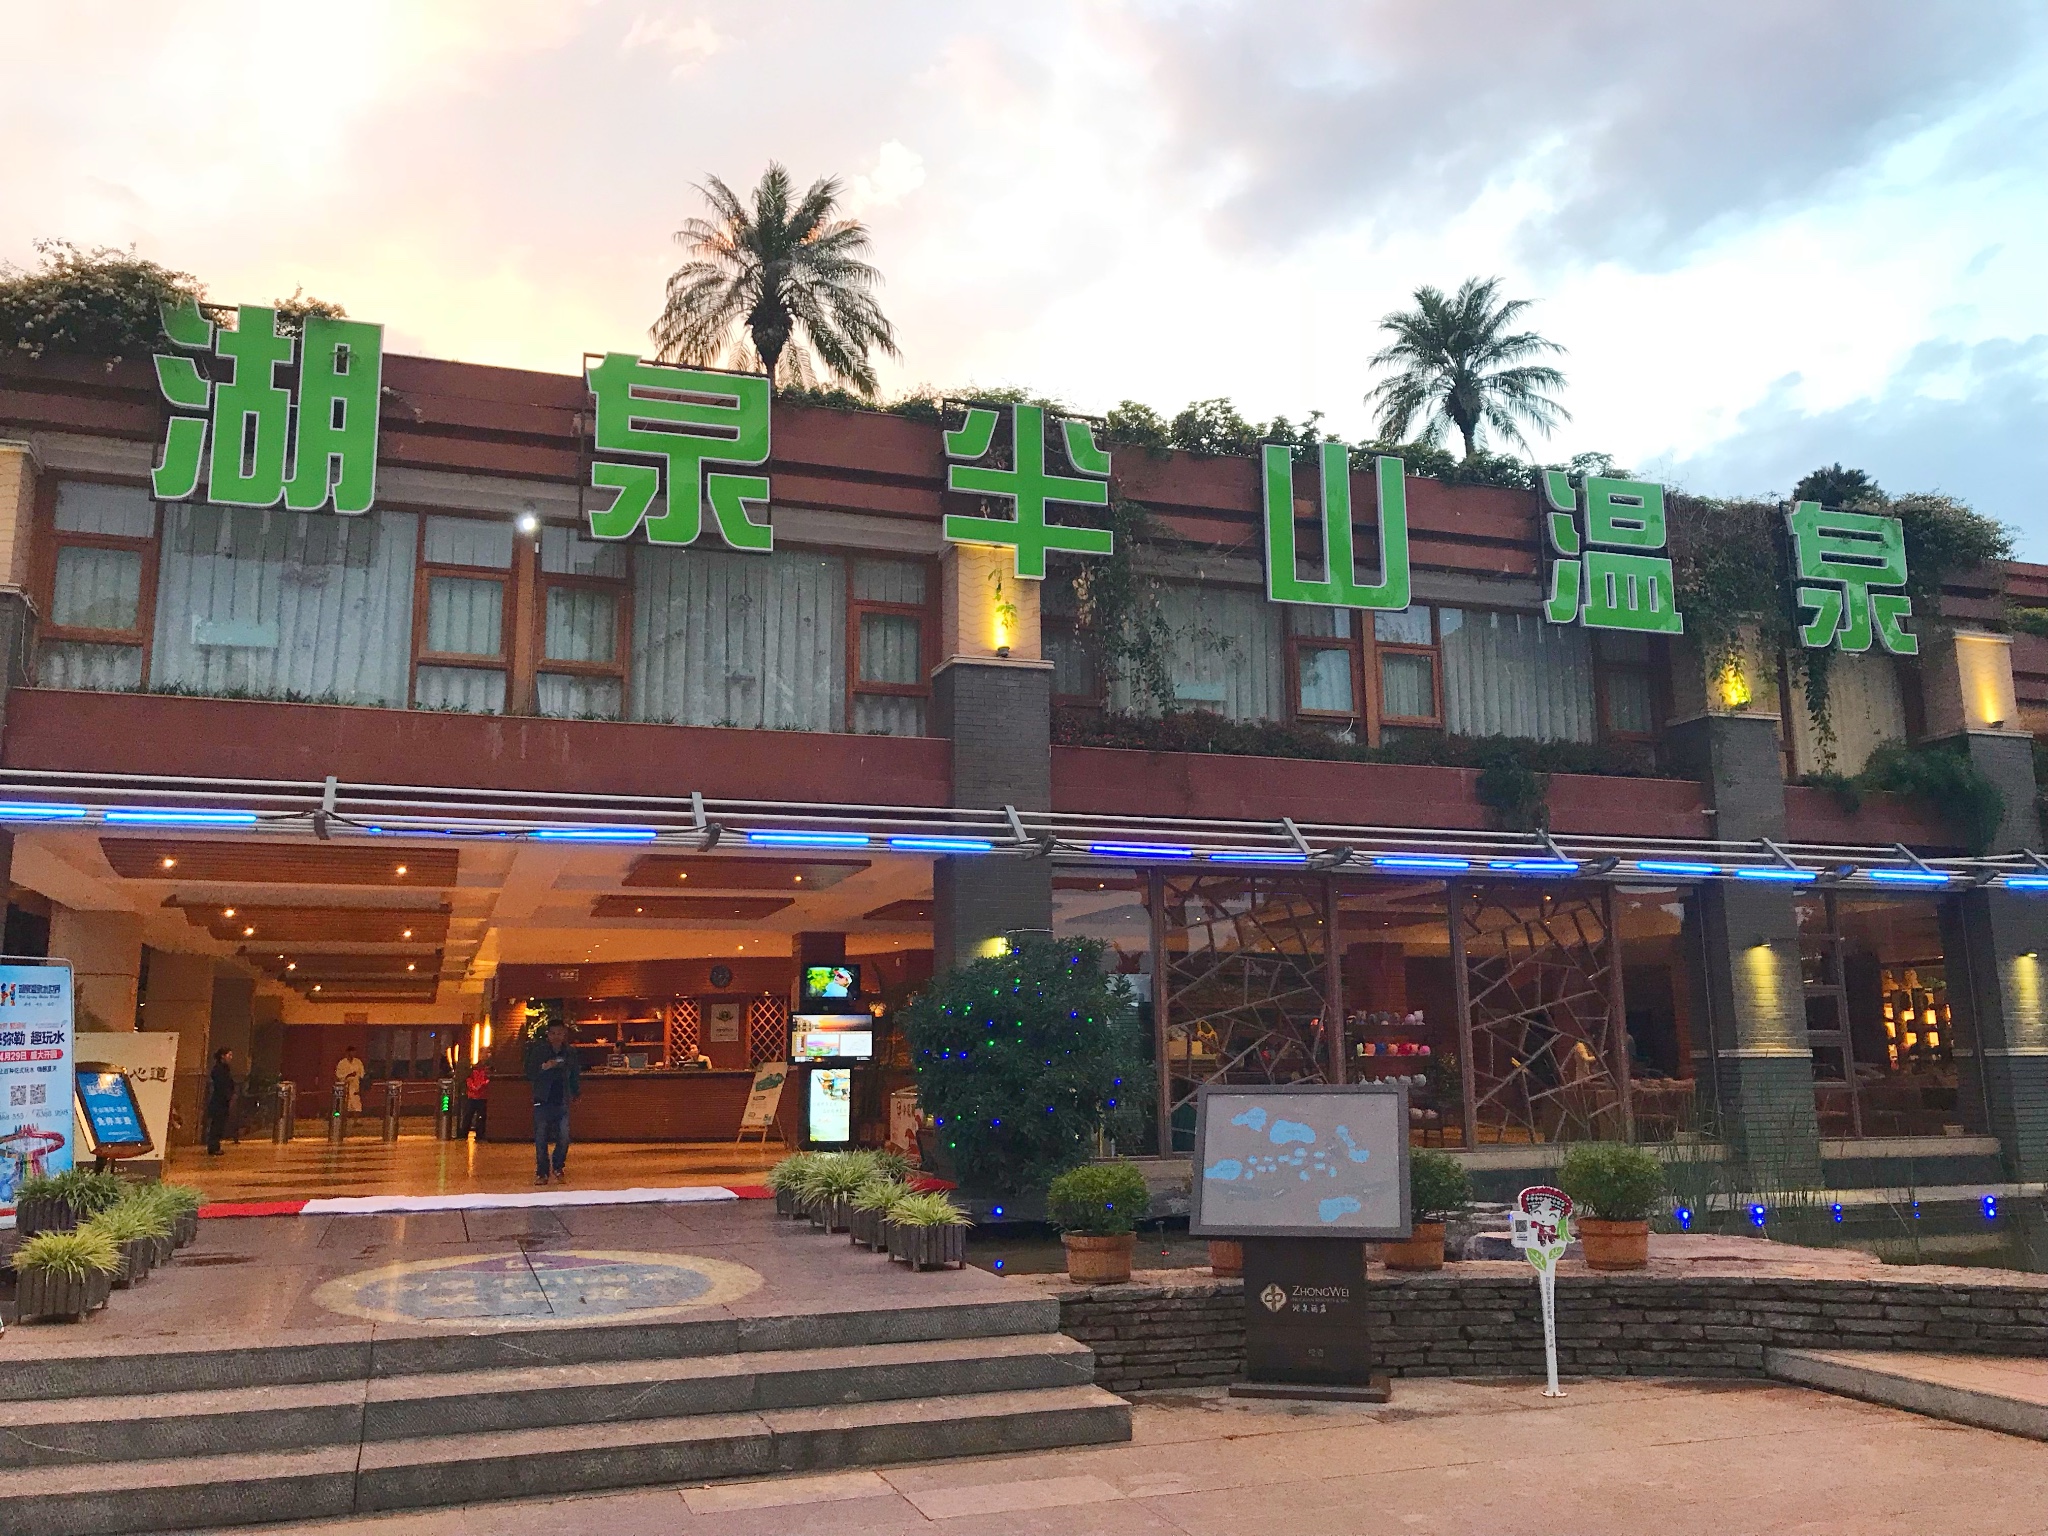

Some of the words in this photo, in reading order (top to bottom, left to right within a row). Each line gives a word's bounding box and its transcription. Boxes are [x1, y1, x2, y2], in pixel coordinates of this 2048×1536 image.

[152, 299, 1918, 656] 湖泉半山温泉
[31, 1030, 65, 1045] 趣玩水
